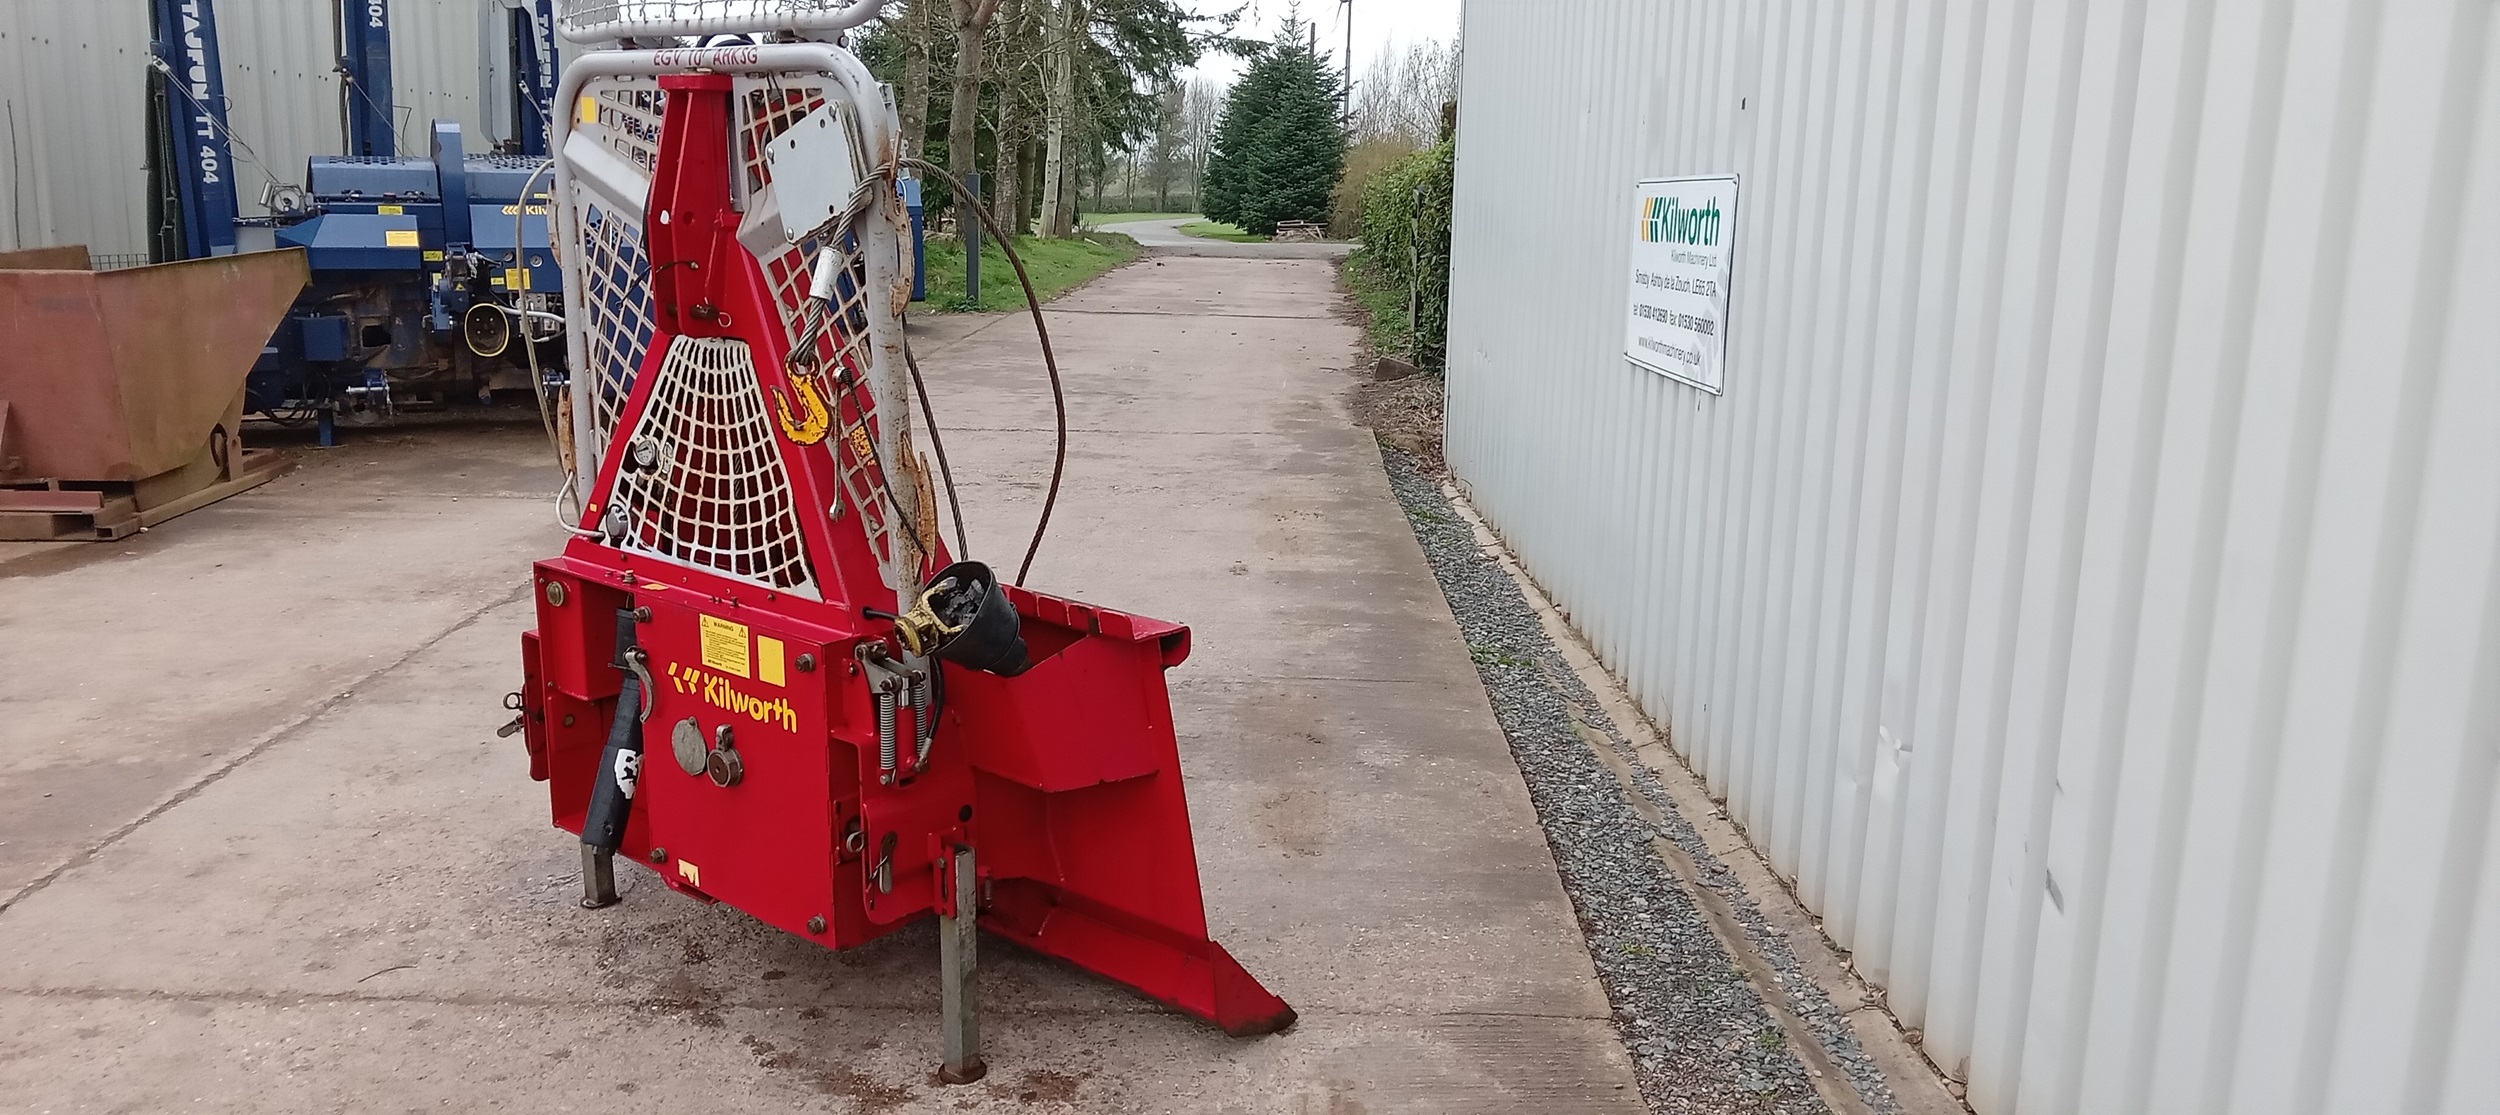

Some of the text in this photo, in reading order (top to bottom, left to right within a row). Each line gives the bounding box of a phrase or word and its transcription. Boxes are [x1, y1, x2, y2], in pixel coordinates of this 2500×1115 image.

[653, 50, 684, 66] EGV
[181, 0, 219, 184] TAJFUN TT 404
[1661, 196, 1720, 247] Kilworth
[1687, 251, 1708, 270] Machinery
[1692, 279, 1705, 295] LE65
[1706, 281, 1716, 298] 2TA
[1639, 304, 1652, 319] 01530
[1678, 313, 1693, 330] 01530
[1694, 317, 1714, 336] 560002
[703, 672, 797, 734] Kilworth
